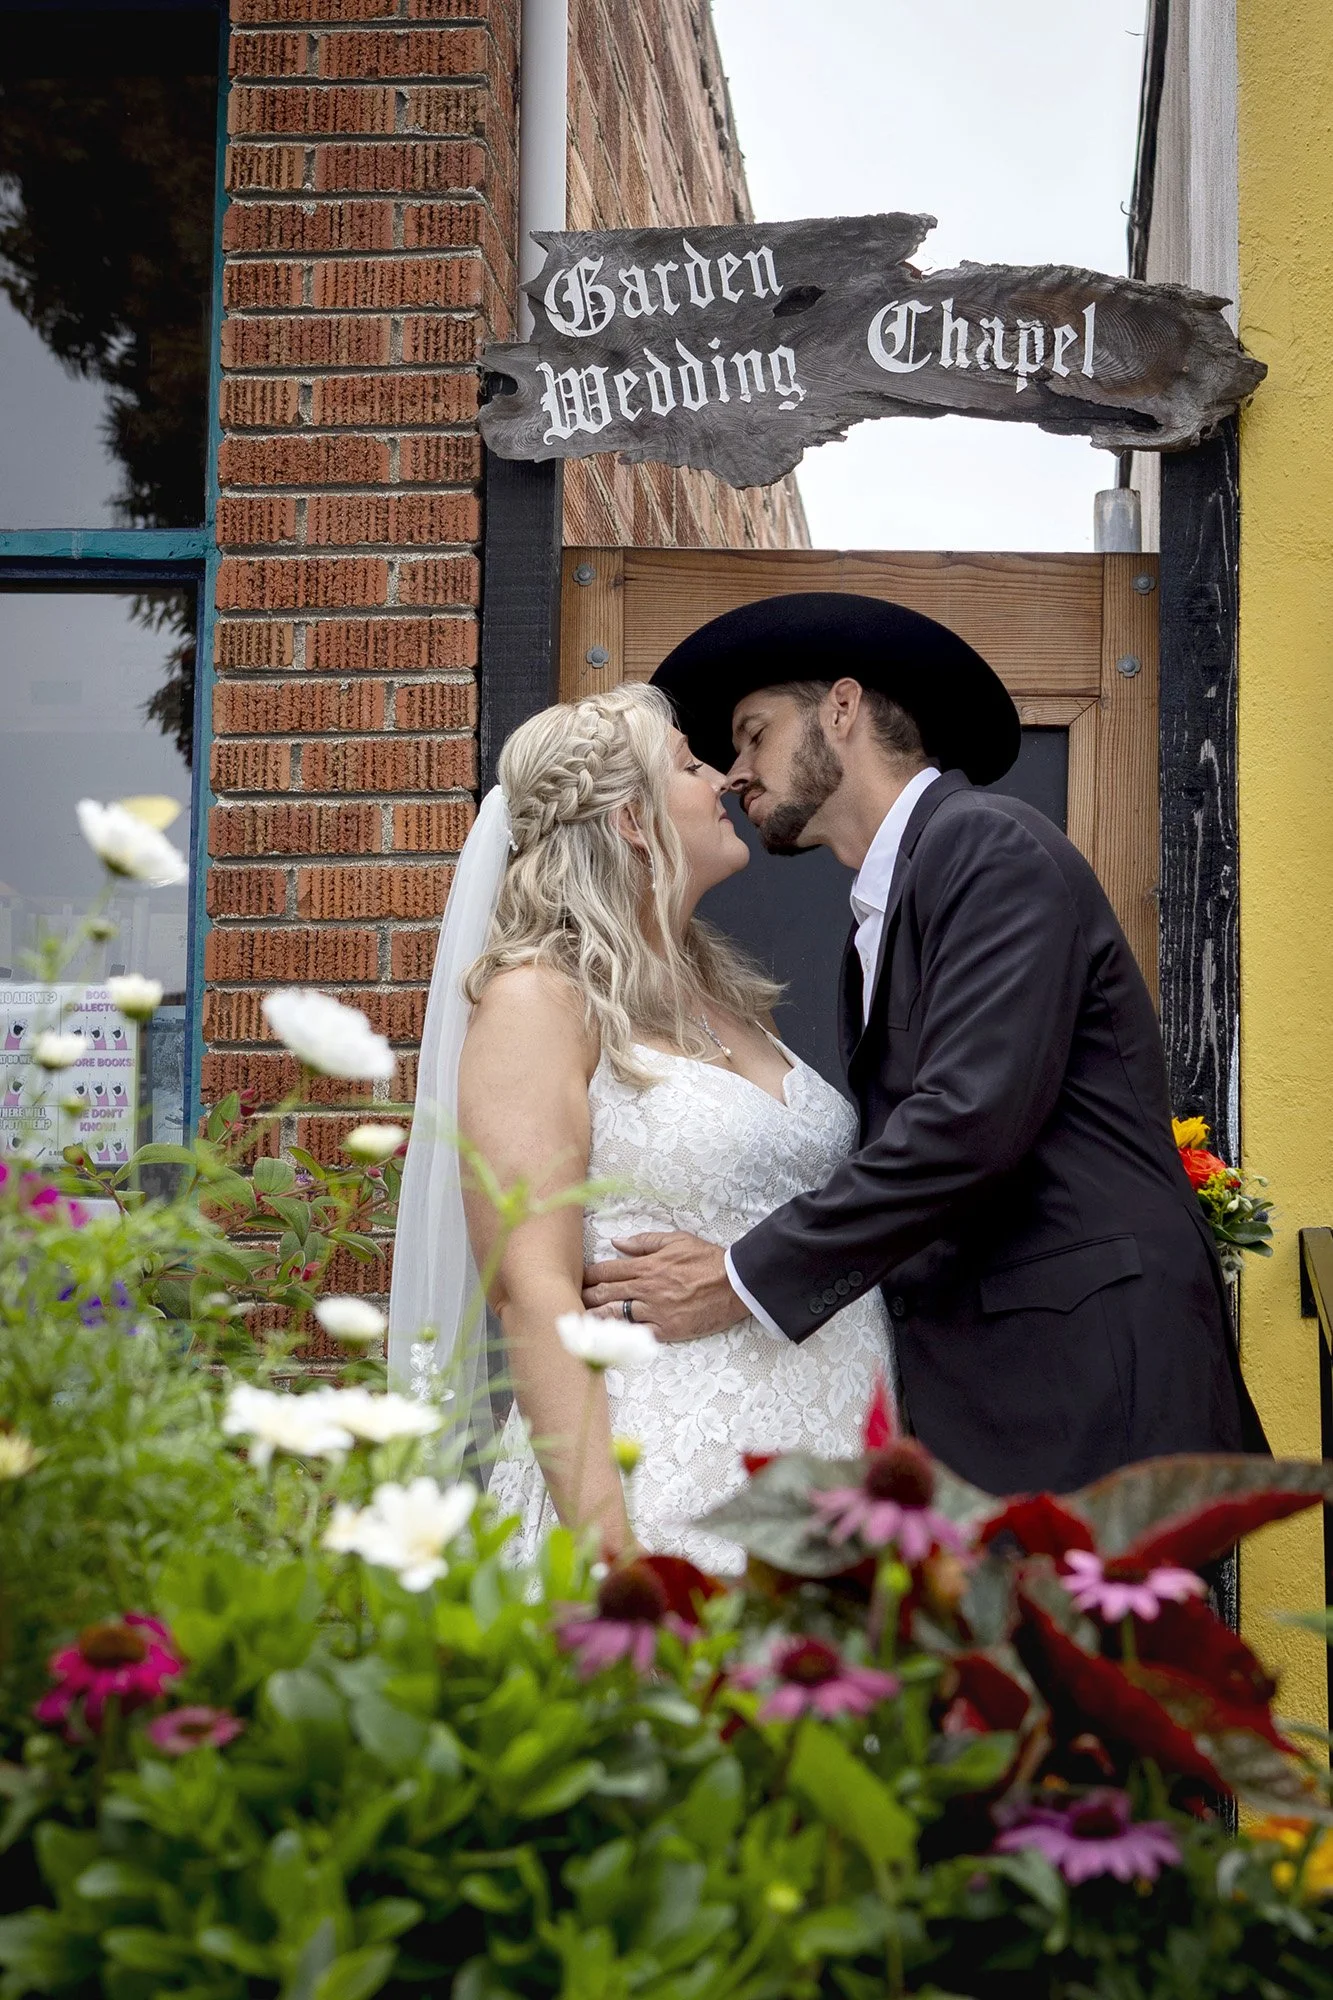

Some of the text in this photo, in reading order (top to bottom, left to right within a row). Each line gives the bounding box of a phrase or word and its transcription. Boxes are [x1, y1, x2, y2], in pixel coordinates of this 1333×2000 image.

[544, 238, 784, 338] Garden
[867, 298, 1096, 393] Chapel
[535, 338, 807, 446] Wedding
[13, 992, 34, 1004] ARE
[34, 991, 58, 1004] WE?
[86, 990, 110, 1000] BOO
[65, 1002, 120, 1013] COLLECTO
[71, 1058, 95, 1067] ORE
[91, 1108, 124, 1118] DON'T
